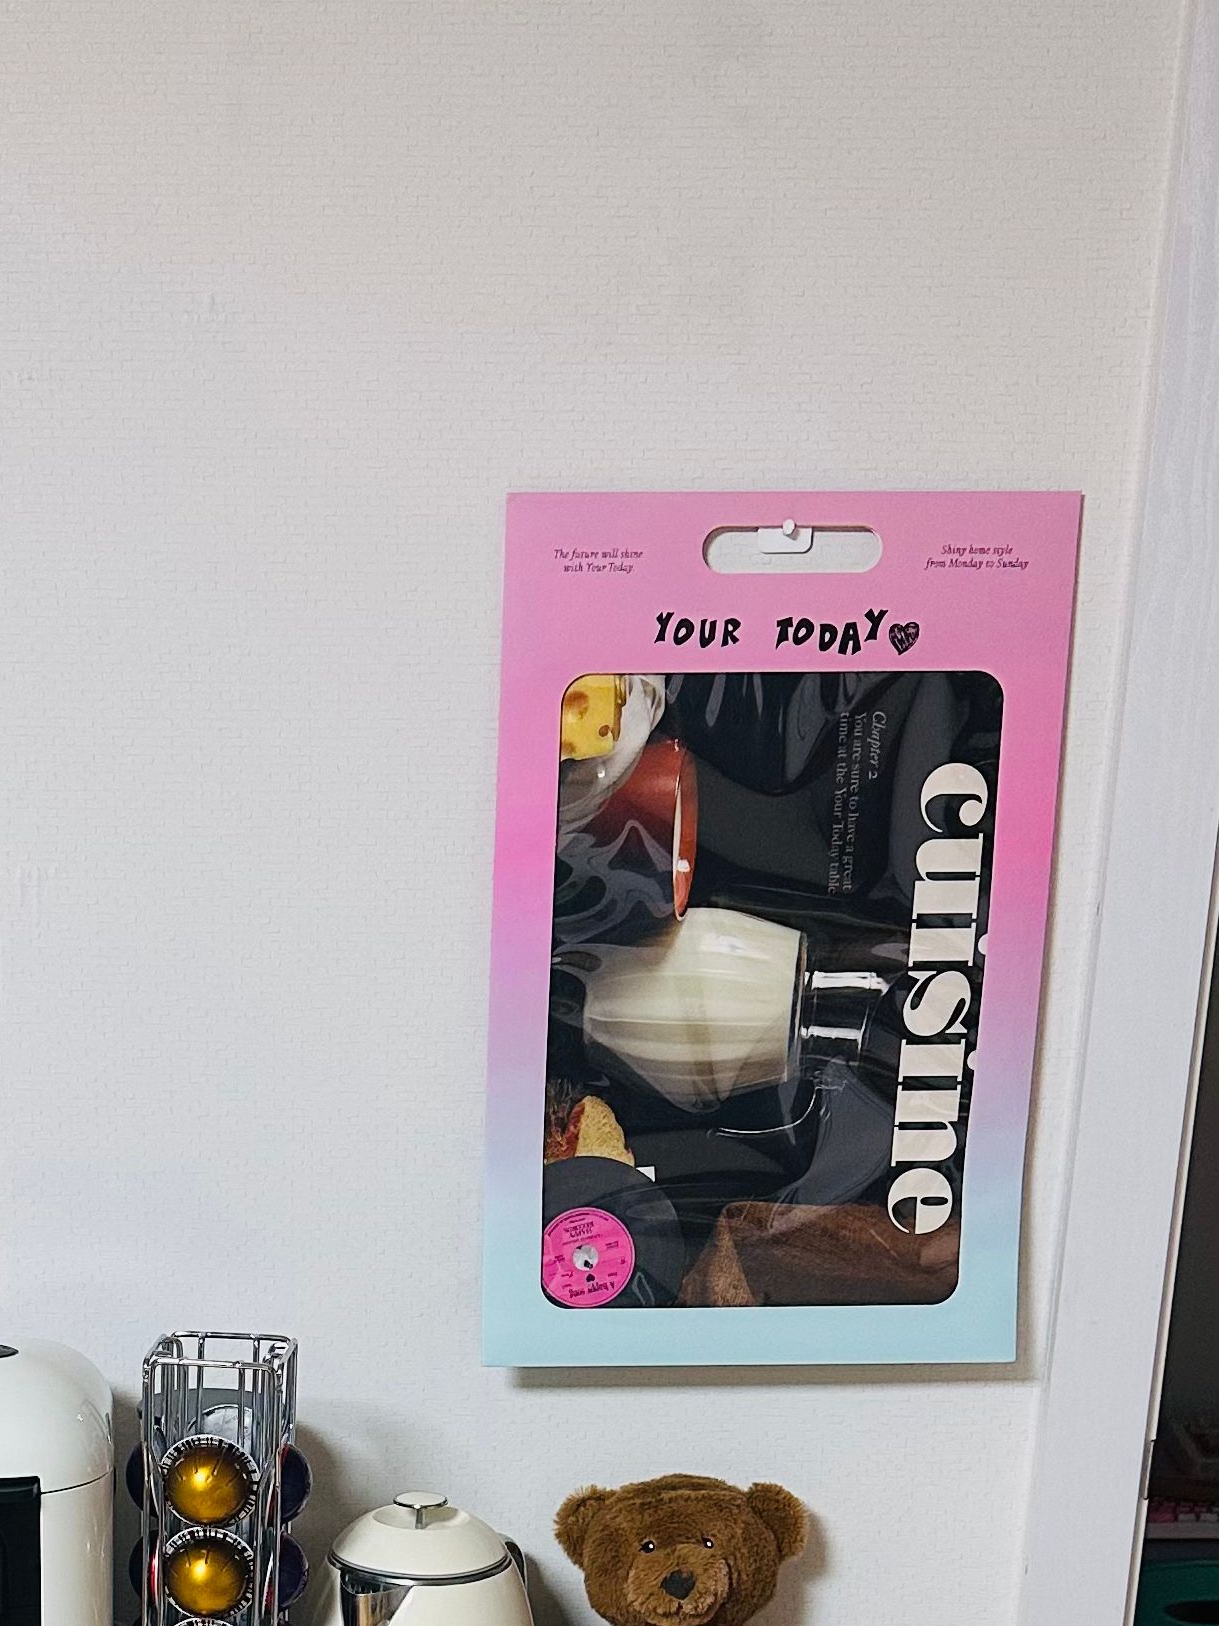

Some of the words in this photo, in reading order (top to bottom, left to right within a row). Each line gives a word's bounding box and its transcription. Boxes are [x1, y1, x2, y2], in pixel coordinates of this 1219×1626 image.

[554, 548, 569, 559] The
[569, 548, 599, 561] future
[601, 548, 619, 559] will
[620, 548, 643, 559] shine
[924, 557, 946, 570] from
[948, 558, 983, 570] Monday
[986, 560, 995, 568] to
[996, 557, 1029, 570] Sunday
[941, 544, 967, 557] Shiny
[969, 544, 990, 555] home
[993, 544, 1013, 557] style
[563, 562, 583, 573] with
[586, 562, 607, 573] Your
[654, 611, 742, 649] YOUR
[775, 608, 888, 656] TODAY
[838, 711, 850, 743] time
[854, 711, 867, 736] You
[837, 746, 847, 758] at
[852, 738, 862, 762] are
[867, 711, 887, 769] Chapter
[835, 762, 848, 784] the
[850, 763, 861, 793] sure
[868, 770, 878, 780] 2
[833, 787, 847, 819] Your
[848, 795, 859, 810] to
[828, 821, 844, 856] Today
[846, 811, 859, 842] have
[827, 862, 841, 895] table
[842, 855, 854, 892] great
[887, 762, 989, 1235] cuisine
